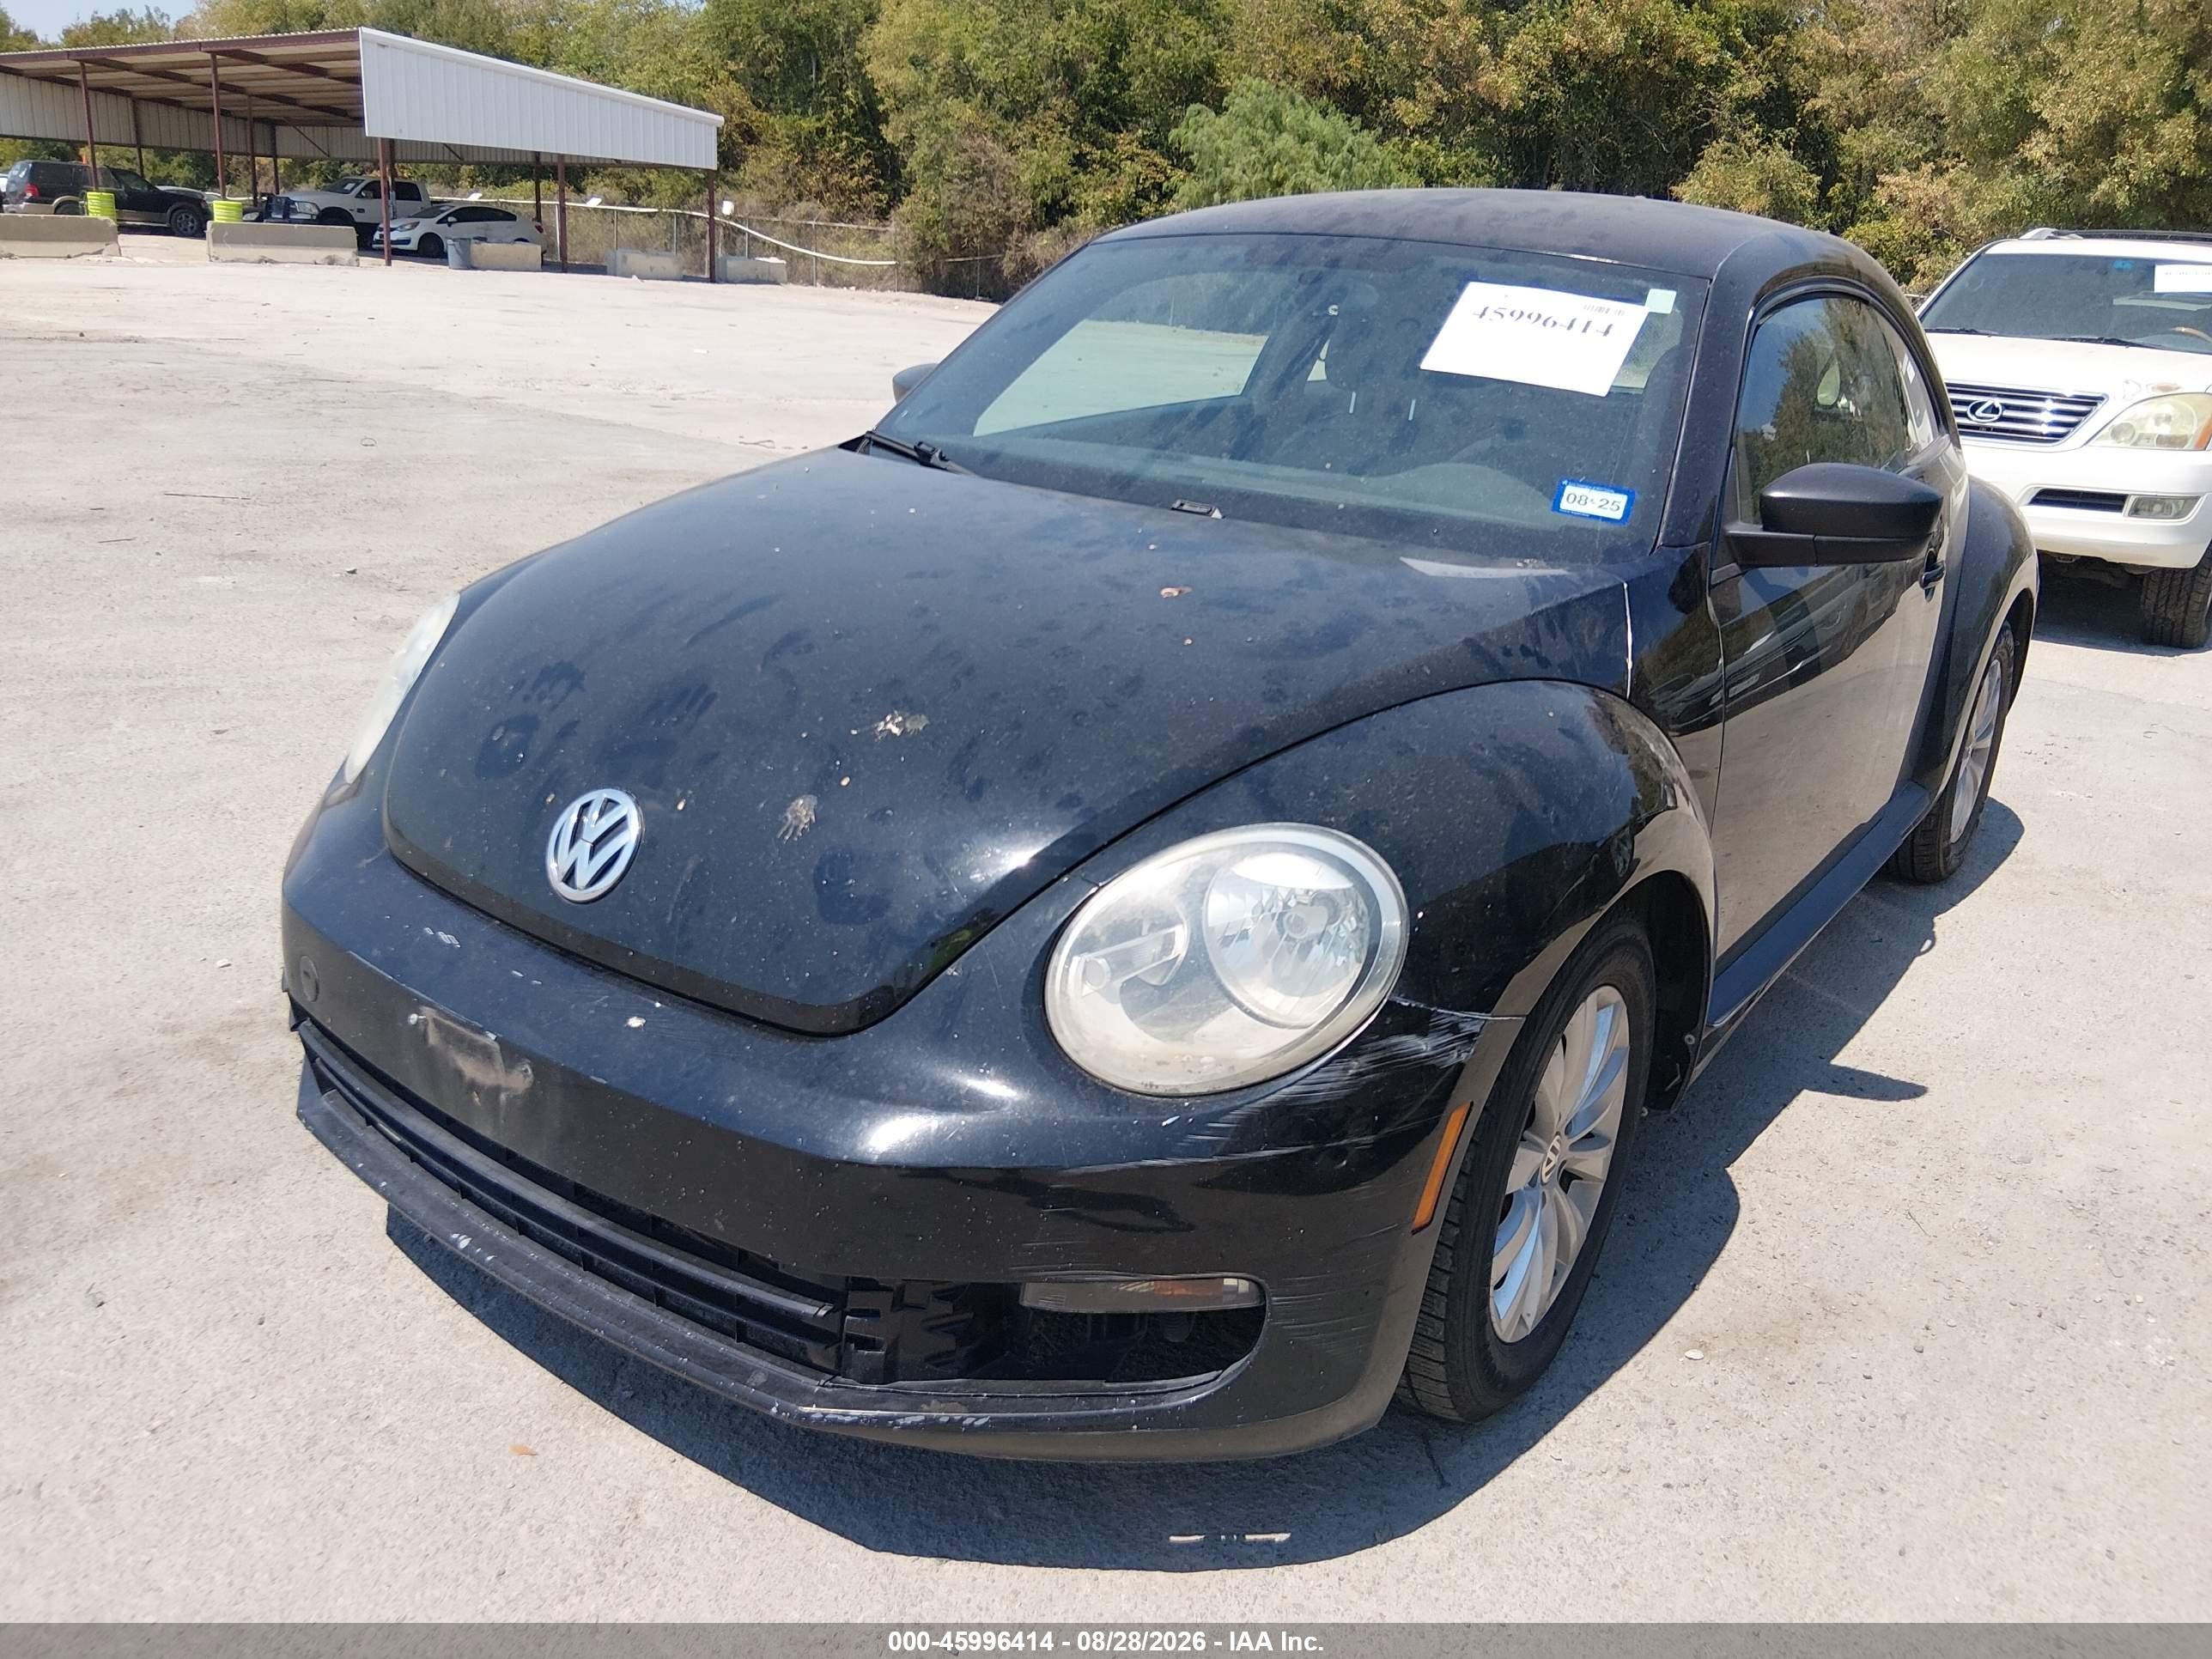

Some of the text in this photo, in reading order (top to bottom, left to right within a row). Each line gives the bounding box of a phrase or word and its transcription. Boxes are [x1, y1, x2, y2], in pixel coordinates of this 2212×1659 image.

[1471, 305, 1615, 337] 45996414
[1565, 492, 1589, 507] 08
[1597, 498, 1621, 513] 25
[552, 791, 637, 896] VW
